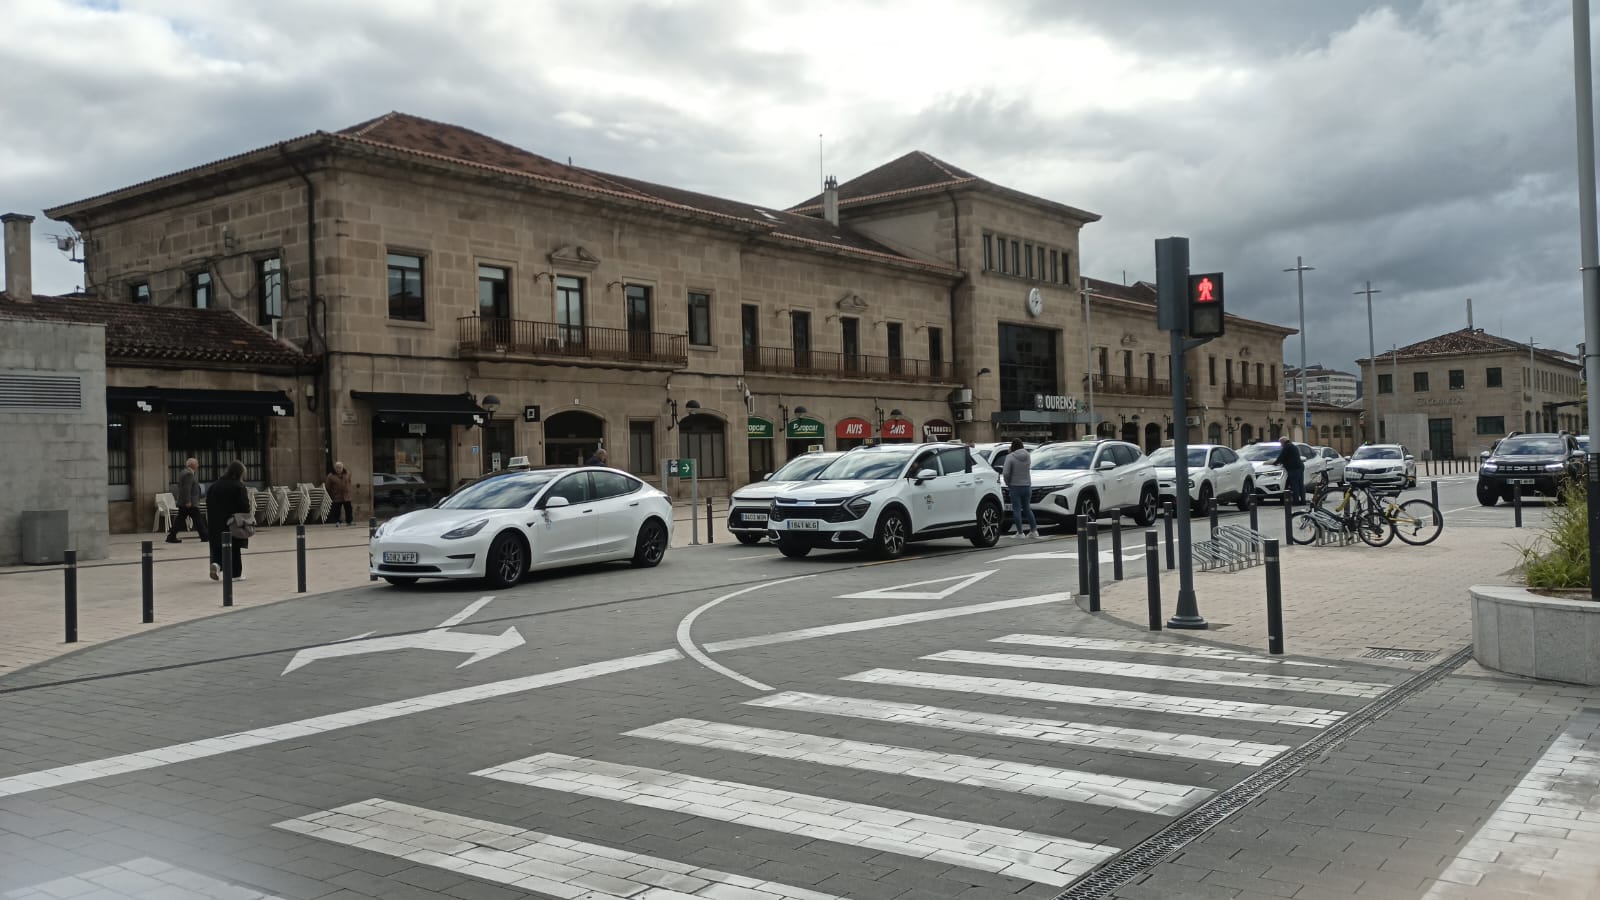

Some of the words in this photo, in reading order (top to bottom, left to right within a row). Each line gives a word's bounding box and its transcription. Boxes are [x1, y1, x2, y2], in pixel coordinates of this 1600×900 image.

[1045, 395, 1077, 410] OURENSE
[748, 424, 766, 433] opcar
[846, 423, 863, 435] AVIS
[890, 424, 906, 435] AVIS
